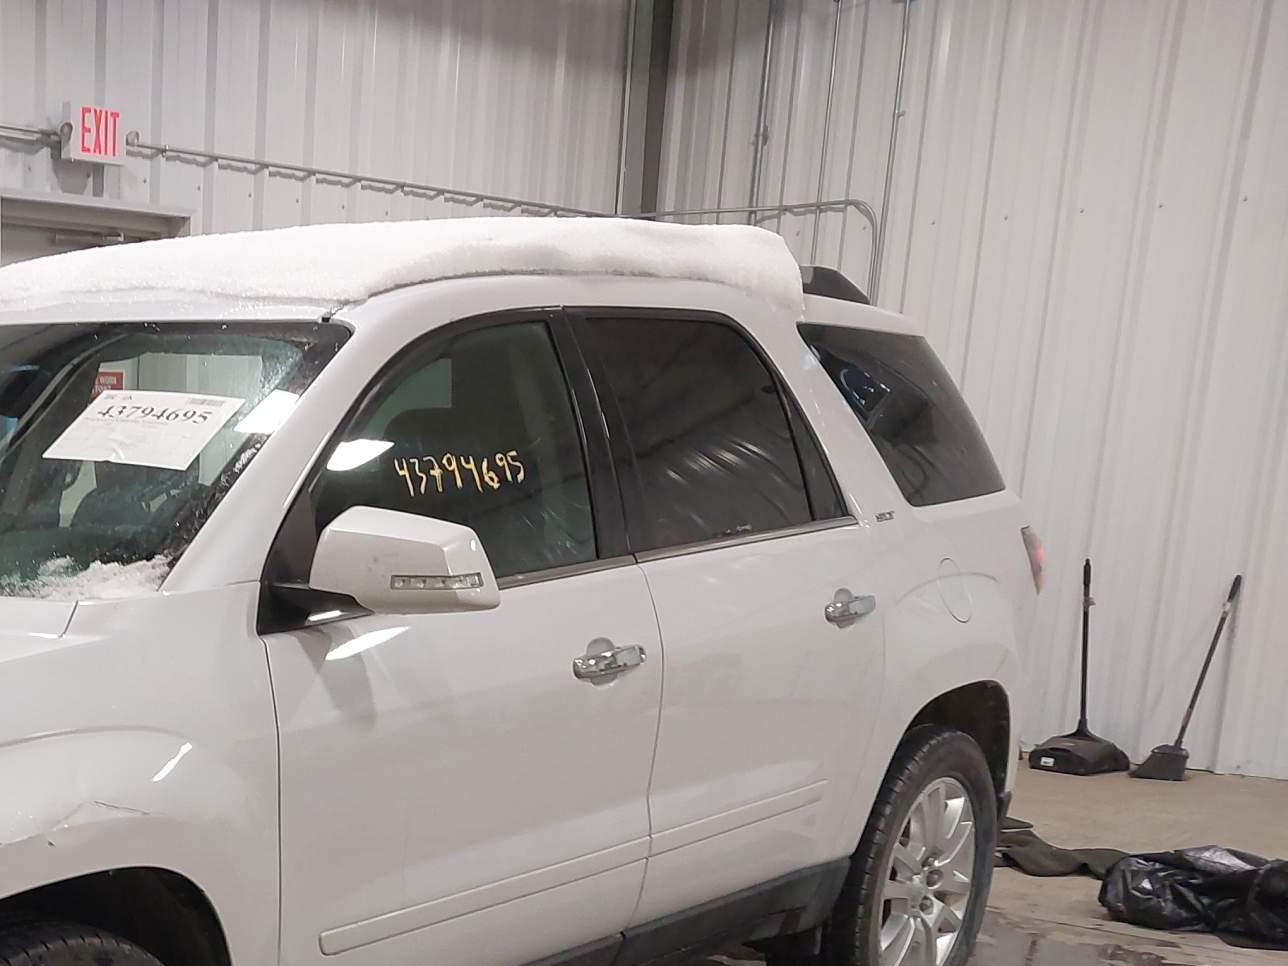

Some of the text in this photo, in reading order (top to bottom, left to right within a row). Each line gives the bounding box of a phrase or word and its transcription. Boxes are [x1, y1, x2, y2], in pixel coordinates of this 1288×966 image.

[81, 106, 120, 157] EXIT
[97, 404, 213, 425] 43794695
[394, 450, 525, 497] 43794695
